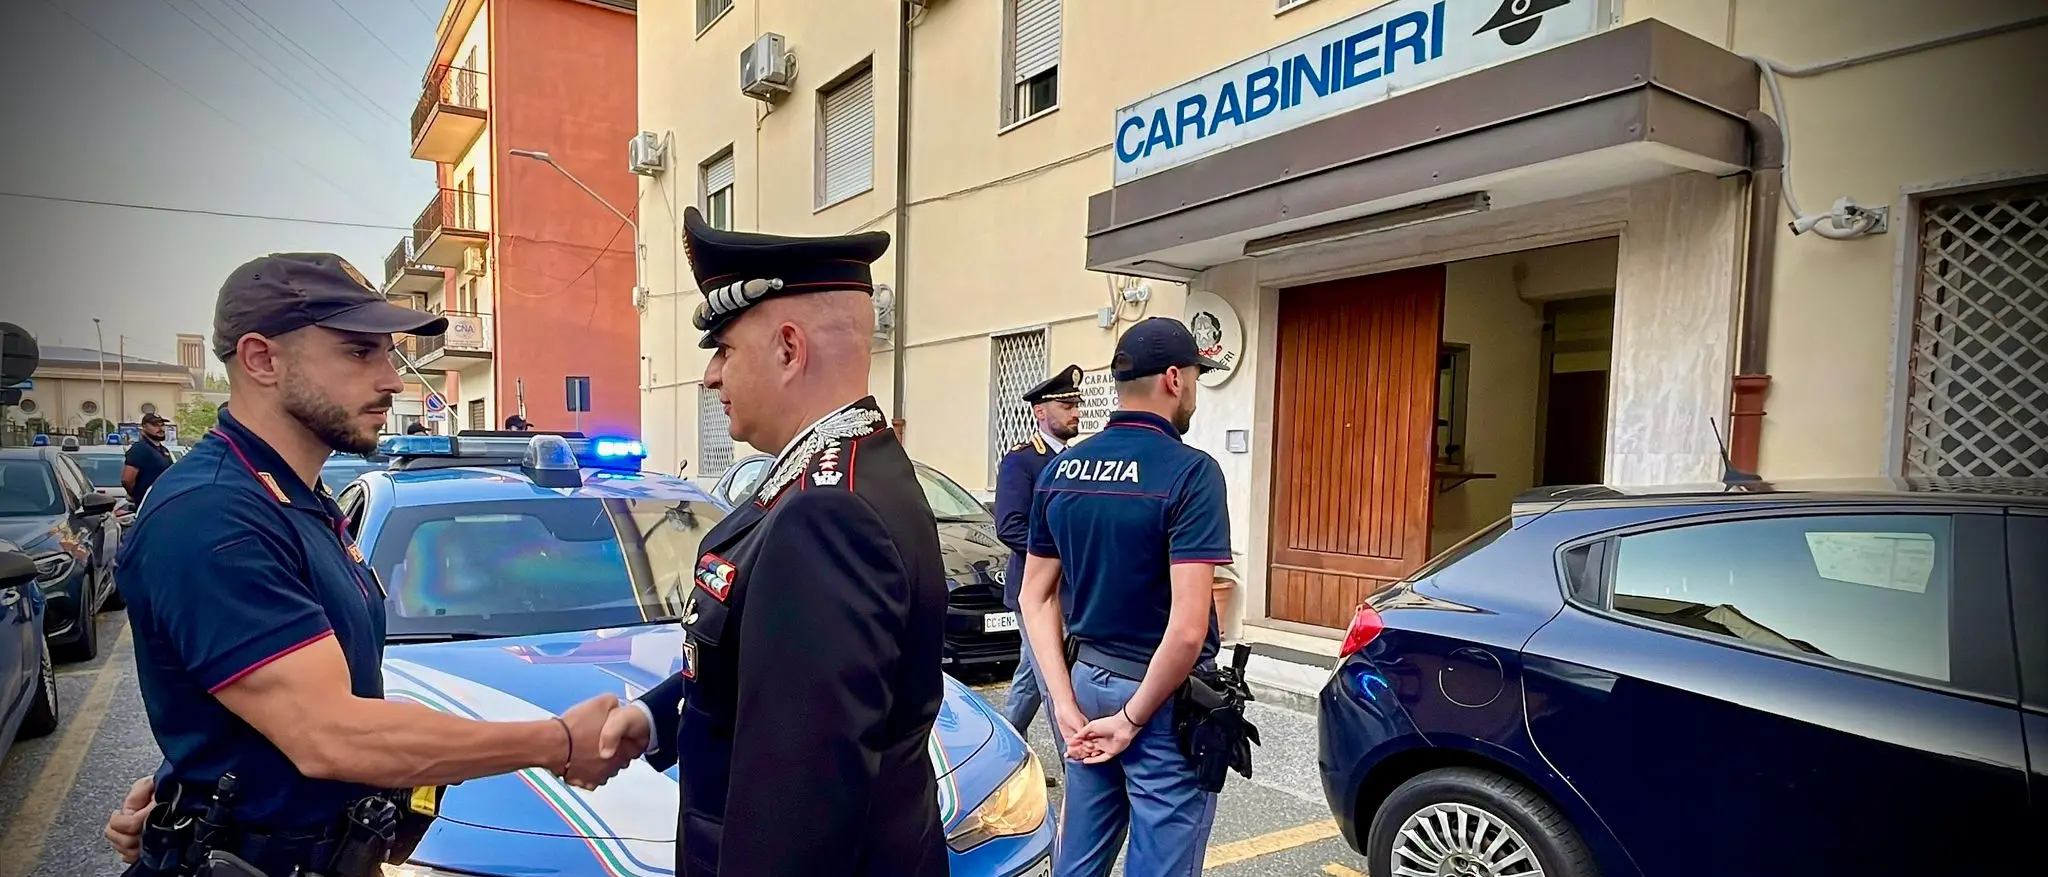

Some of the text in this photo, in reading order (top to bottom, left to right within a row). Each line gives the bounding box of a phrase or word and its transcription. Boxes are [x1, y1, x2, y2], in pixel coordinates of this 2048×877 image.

[1116, 1, 1446, 163] CARABINIERI
[455, 324, 474, 333] CNA
[1085, 374, 1114, 385] CARAB
[1079, 409, 1111, 418] OMANDO
[1081, 421, 1099, 429] VIBO
[1055, 459, 1138, 483] POLIZIA
